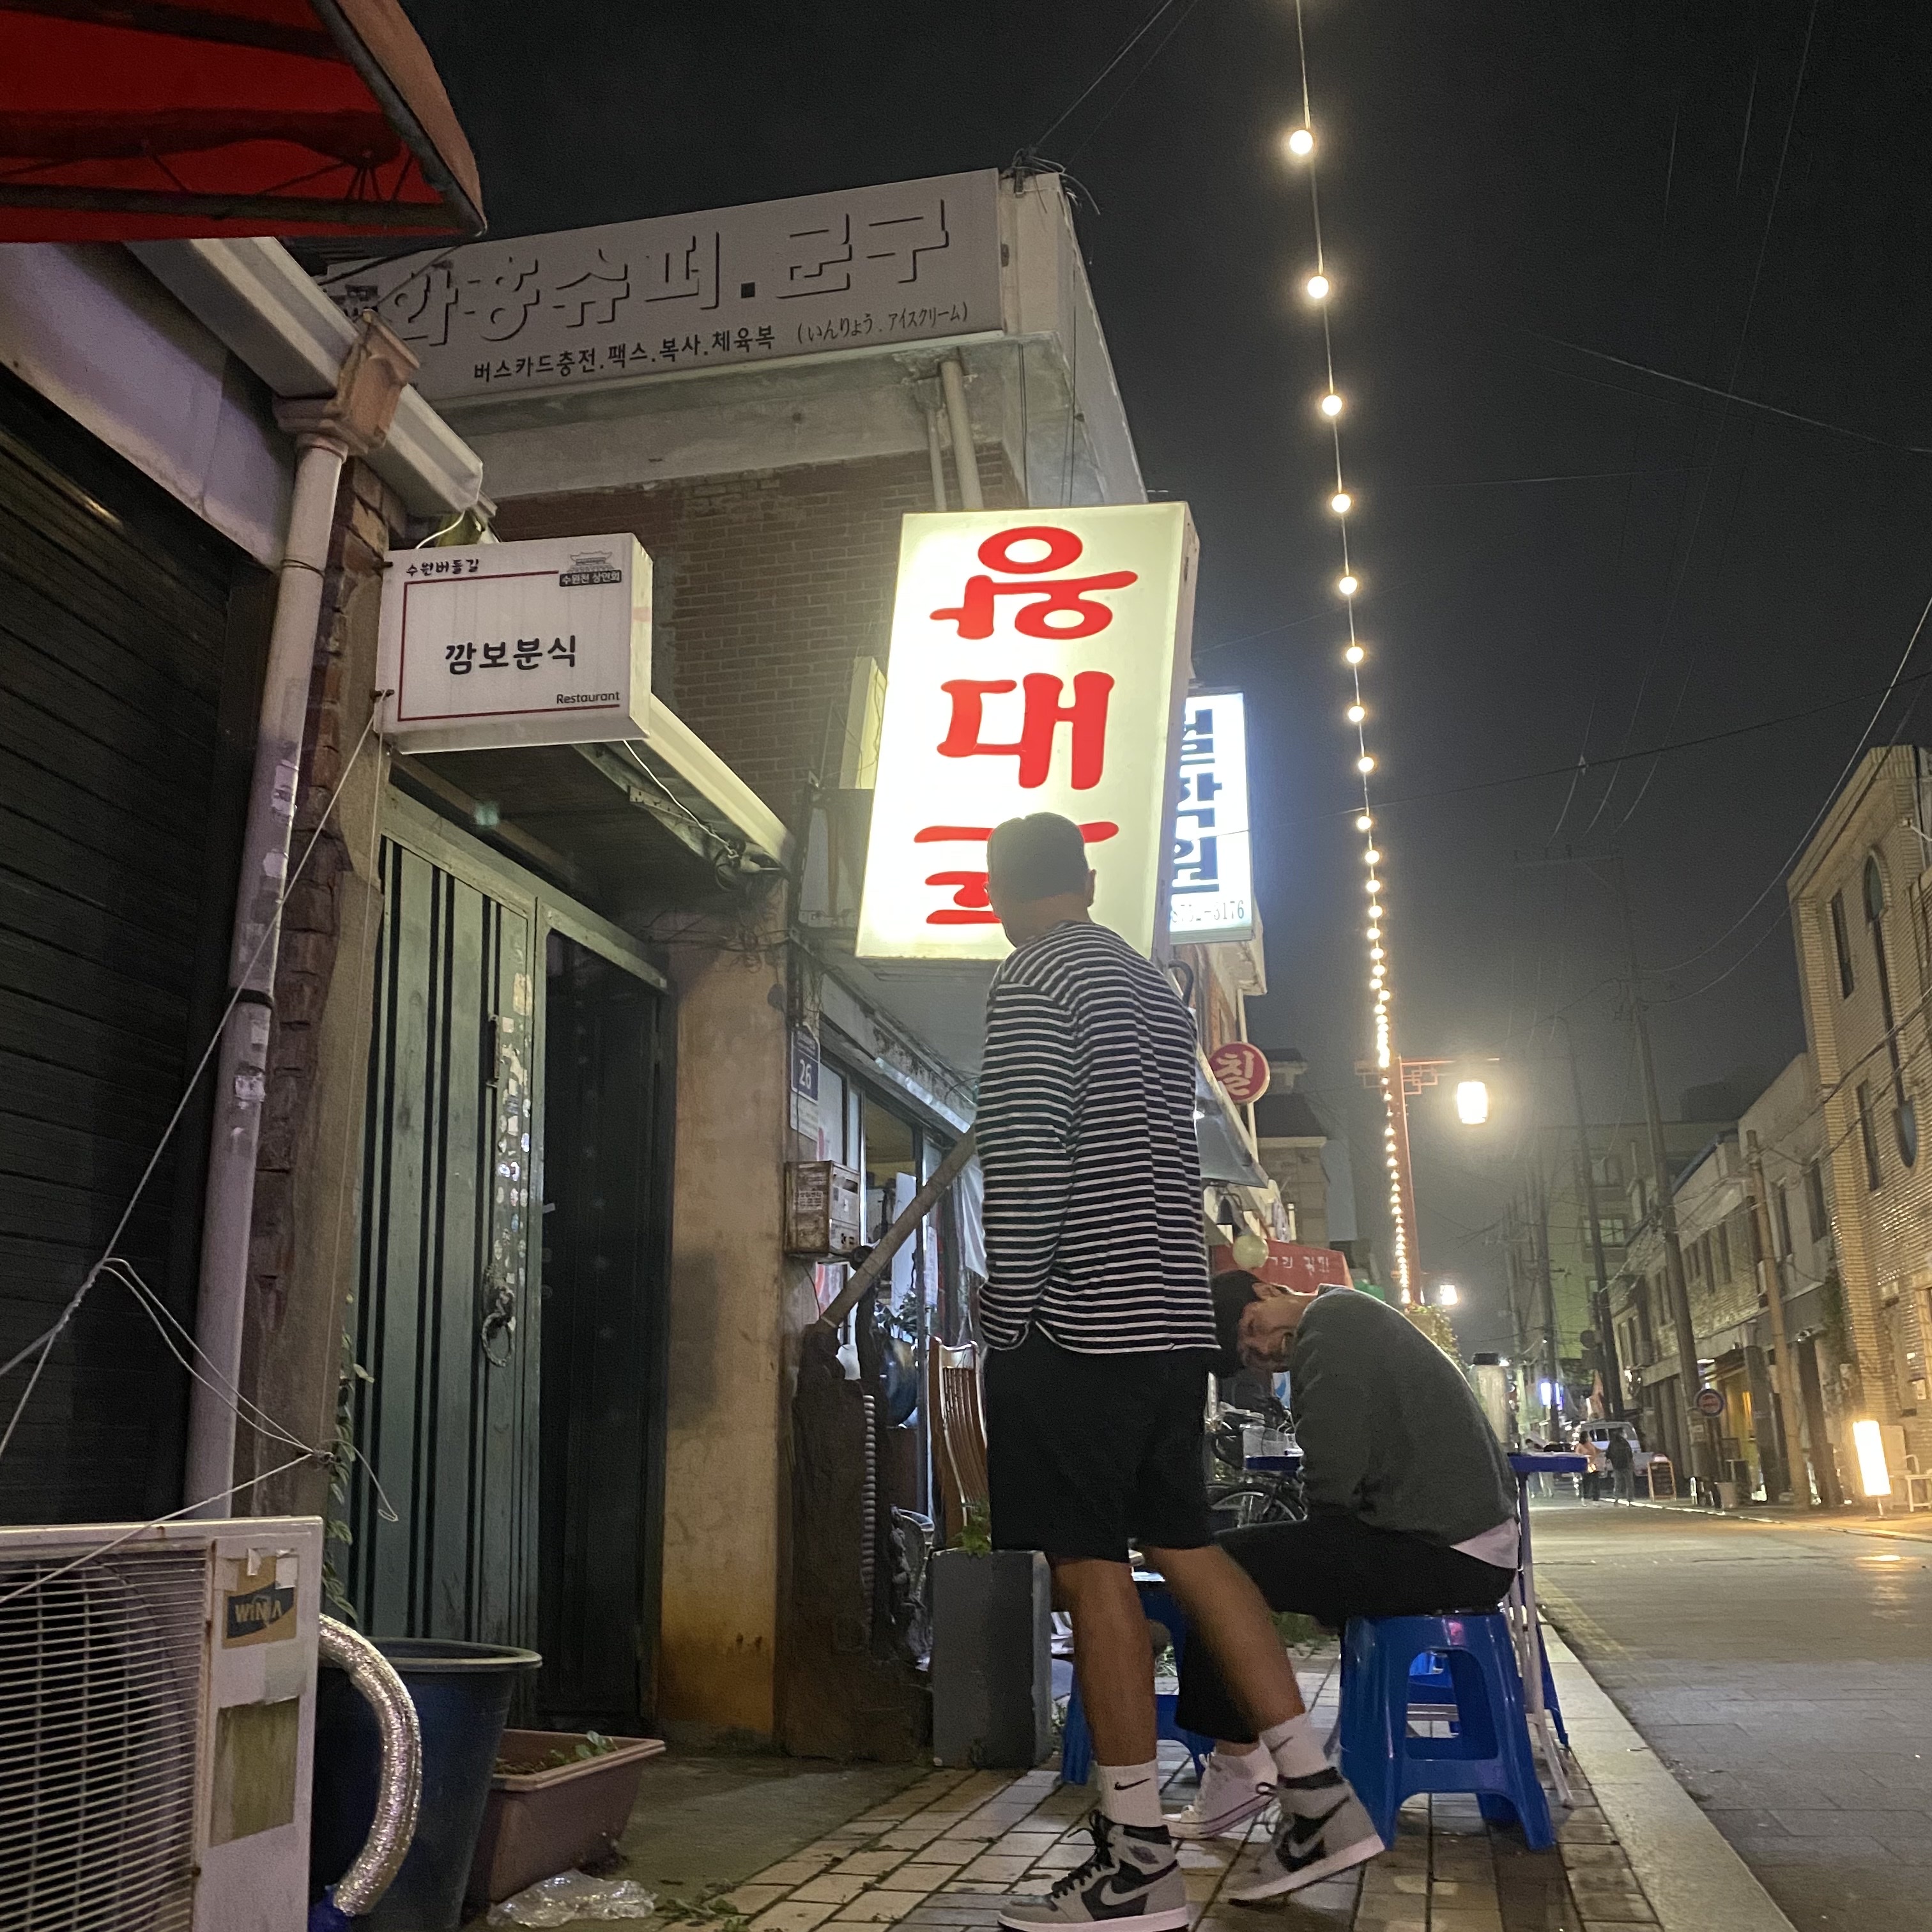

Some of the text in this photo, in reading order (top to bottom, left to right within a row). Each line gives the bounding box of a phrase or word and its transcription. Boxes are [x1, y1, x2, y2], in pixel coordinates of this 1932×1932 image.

[446, 634, 576, 675] 깜보분식
[556, 691, 620, 704] Restaurant
[799, 1059, 811, 1089] 26
[234, 1599, 282, 1623] WINA
